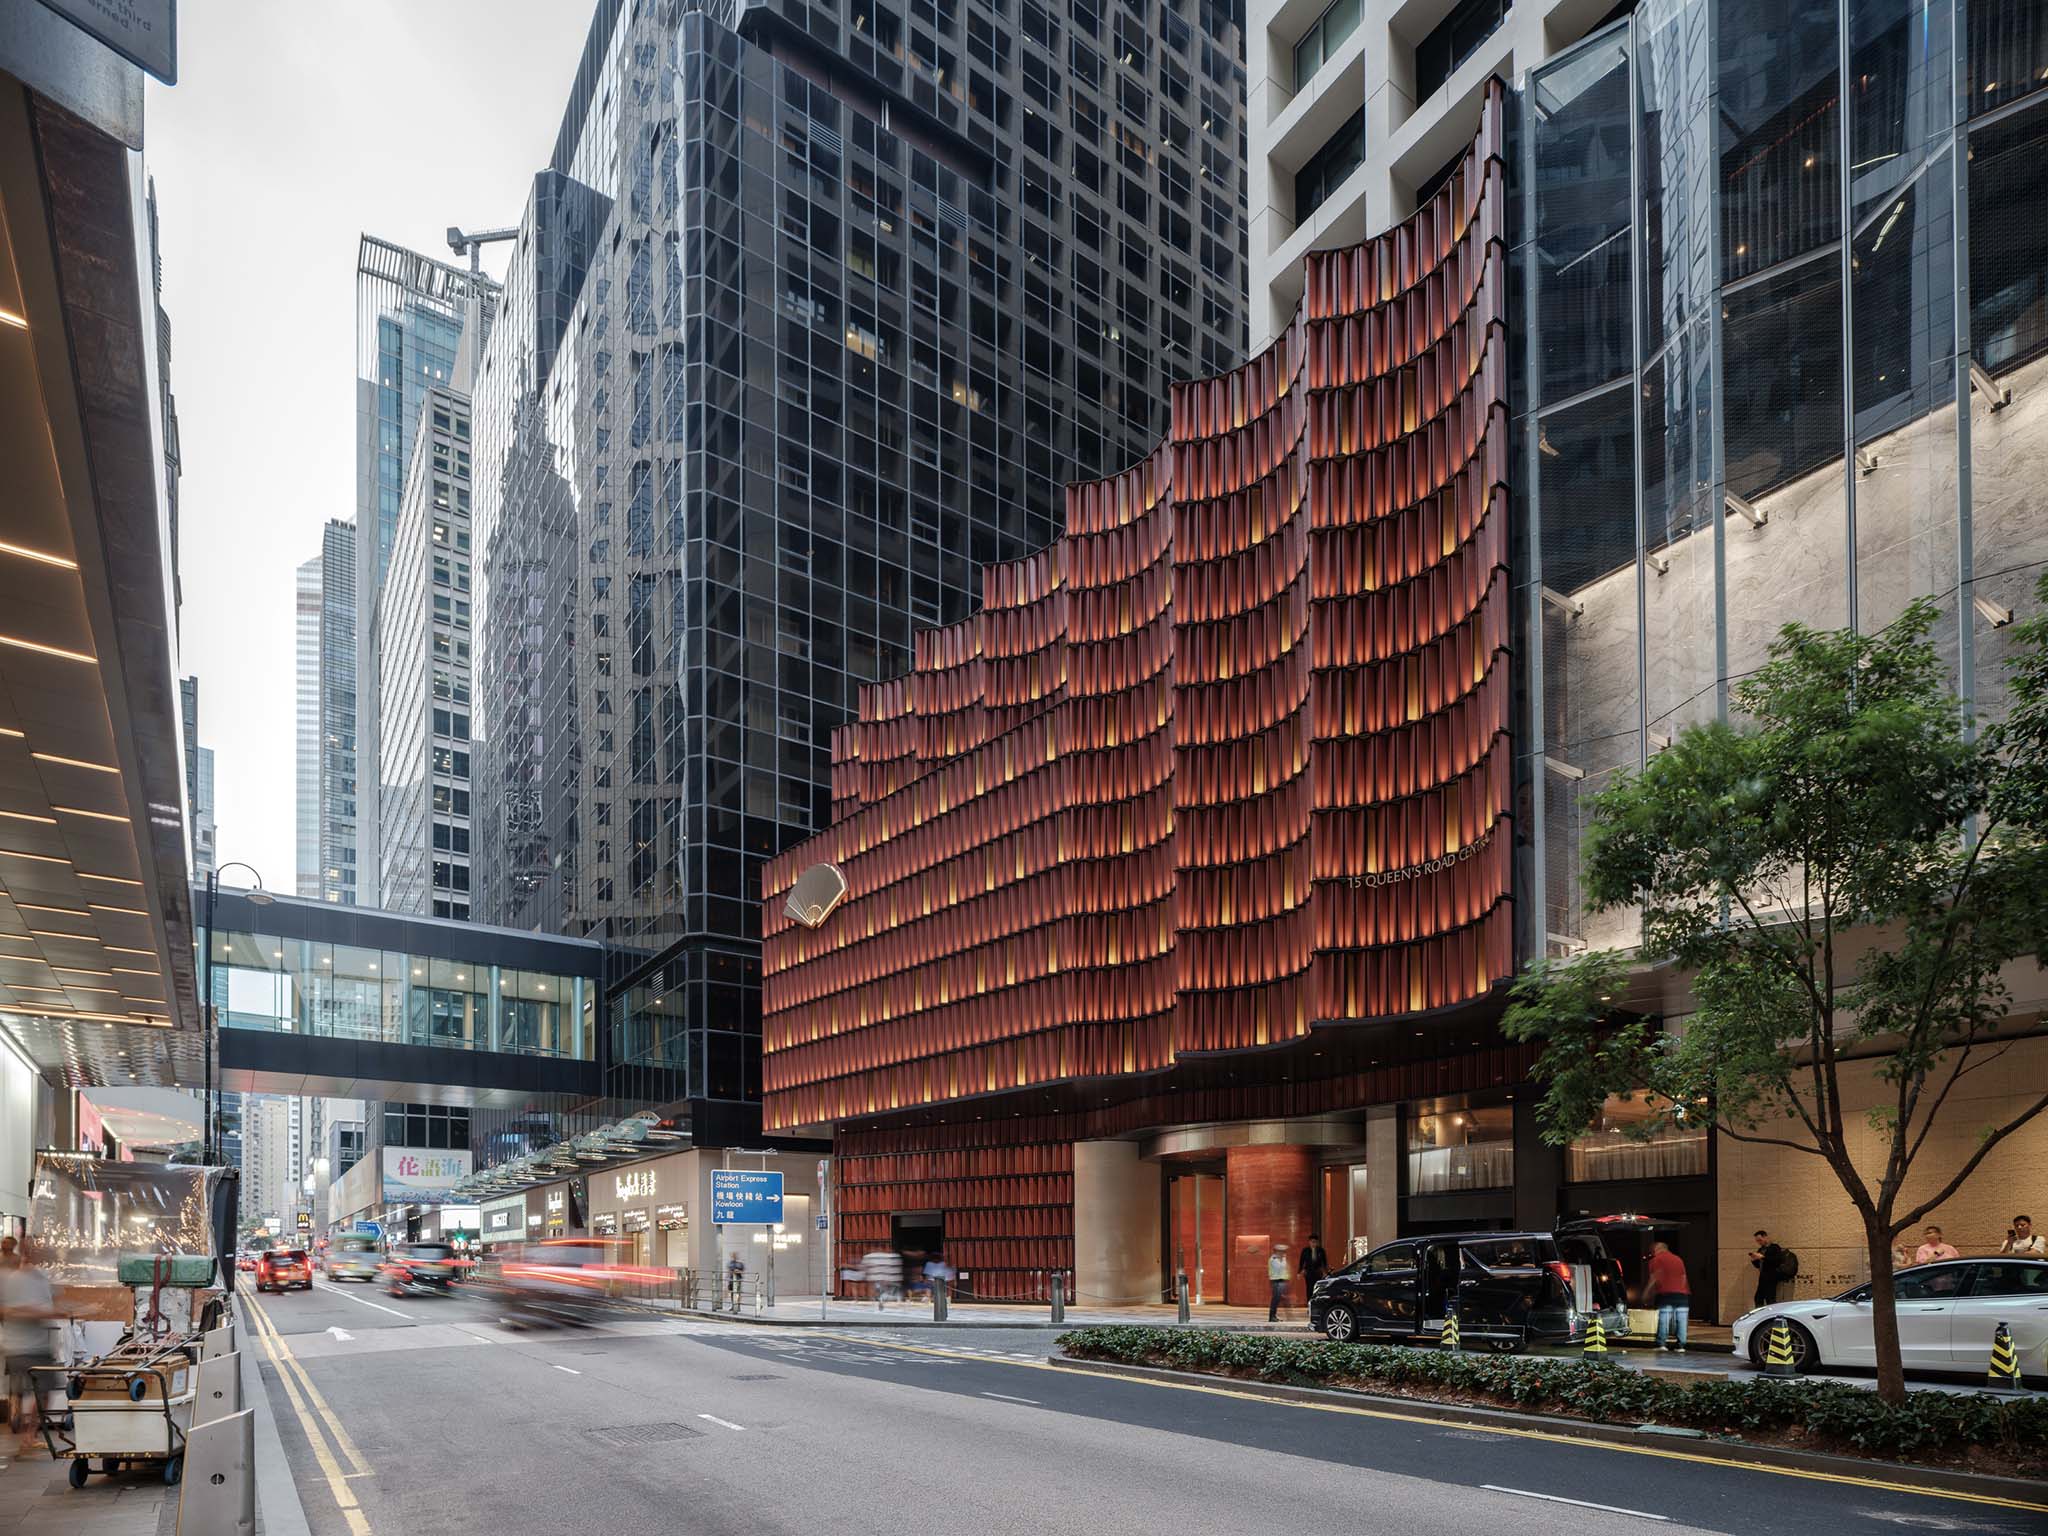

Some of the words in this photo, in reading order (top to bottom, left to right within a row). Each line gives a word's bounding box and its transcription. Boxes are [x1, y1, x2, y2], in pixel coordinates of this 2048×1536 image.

[1347, 877, 1362, 889] 15
[1365, 865, 1421, 889] QUEEN'S
[1424, 854, 1456, 875] ROAD
[715, 1174, 739, 1182] Airport
[740, 1174, 768, 1183] Express
[715, 1181, 740, 1189] Station
[715, 1200, 744, 1208] Kowloon
